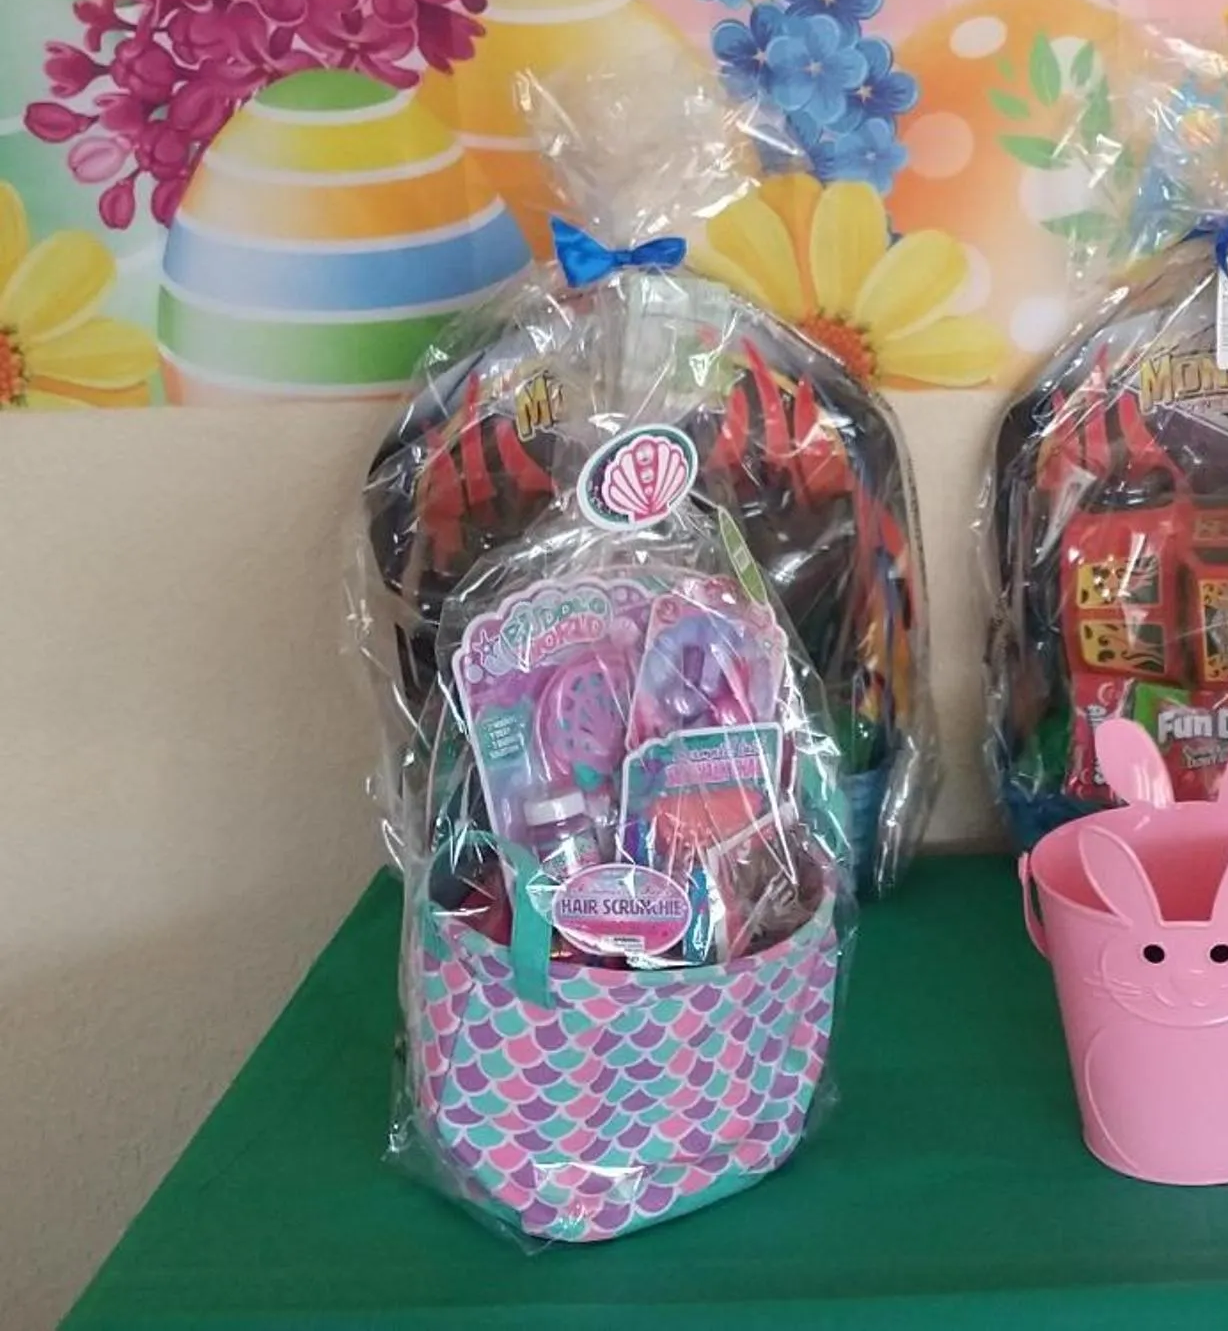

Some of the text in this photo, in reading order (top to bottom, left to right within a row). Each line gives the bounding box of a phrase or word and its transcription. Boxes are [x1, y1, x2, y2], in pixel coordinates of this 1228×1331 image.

[1158, 710, 1213, 745] Fun
[561, 898, 682, 917] HAIR SCRUNCHIE
